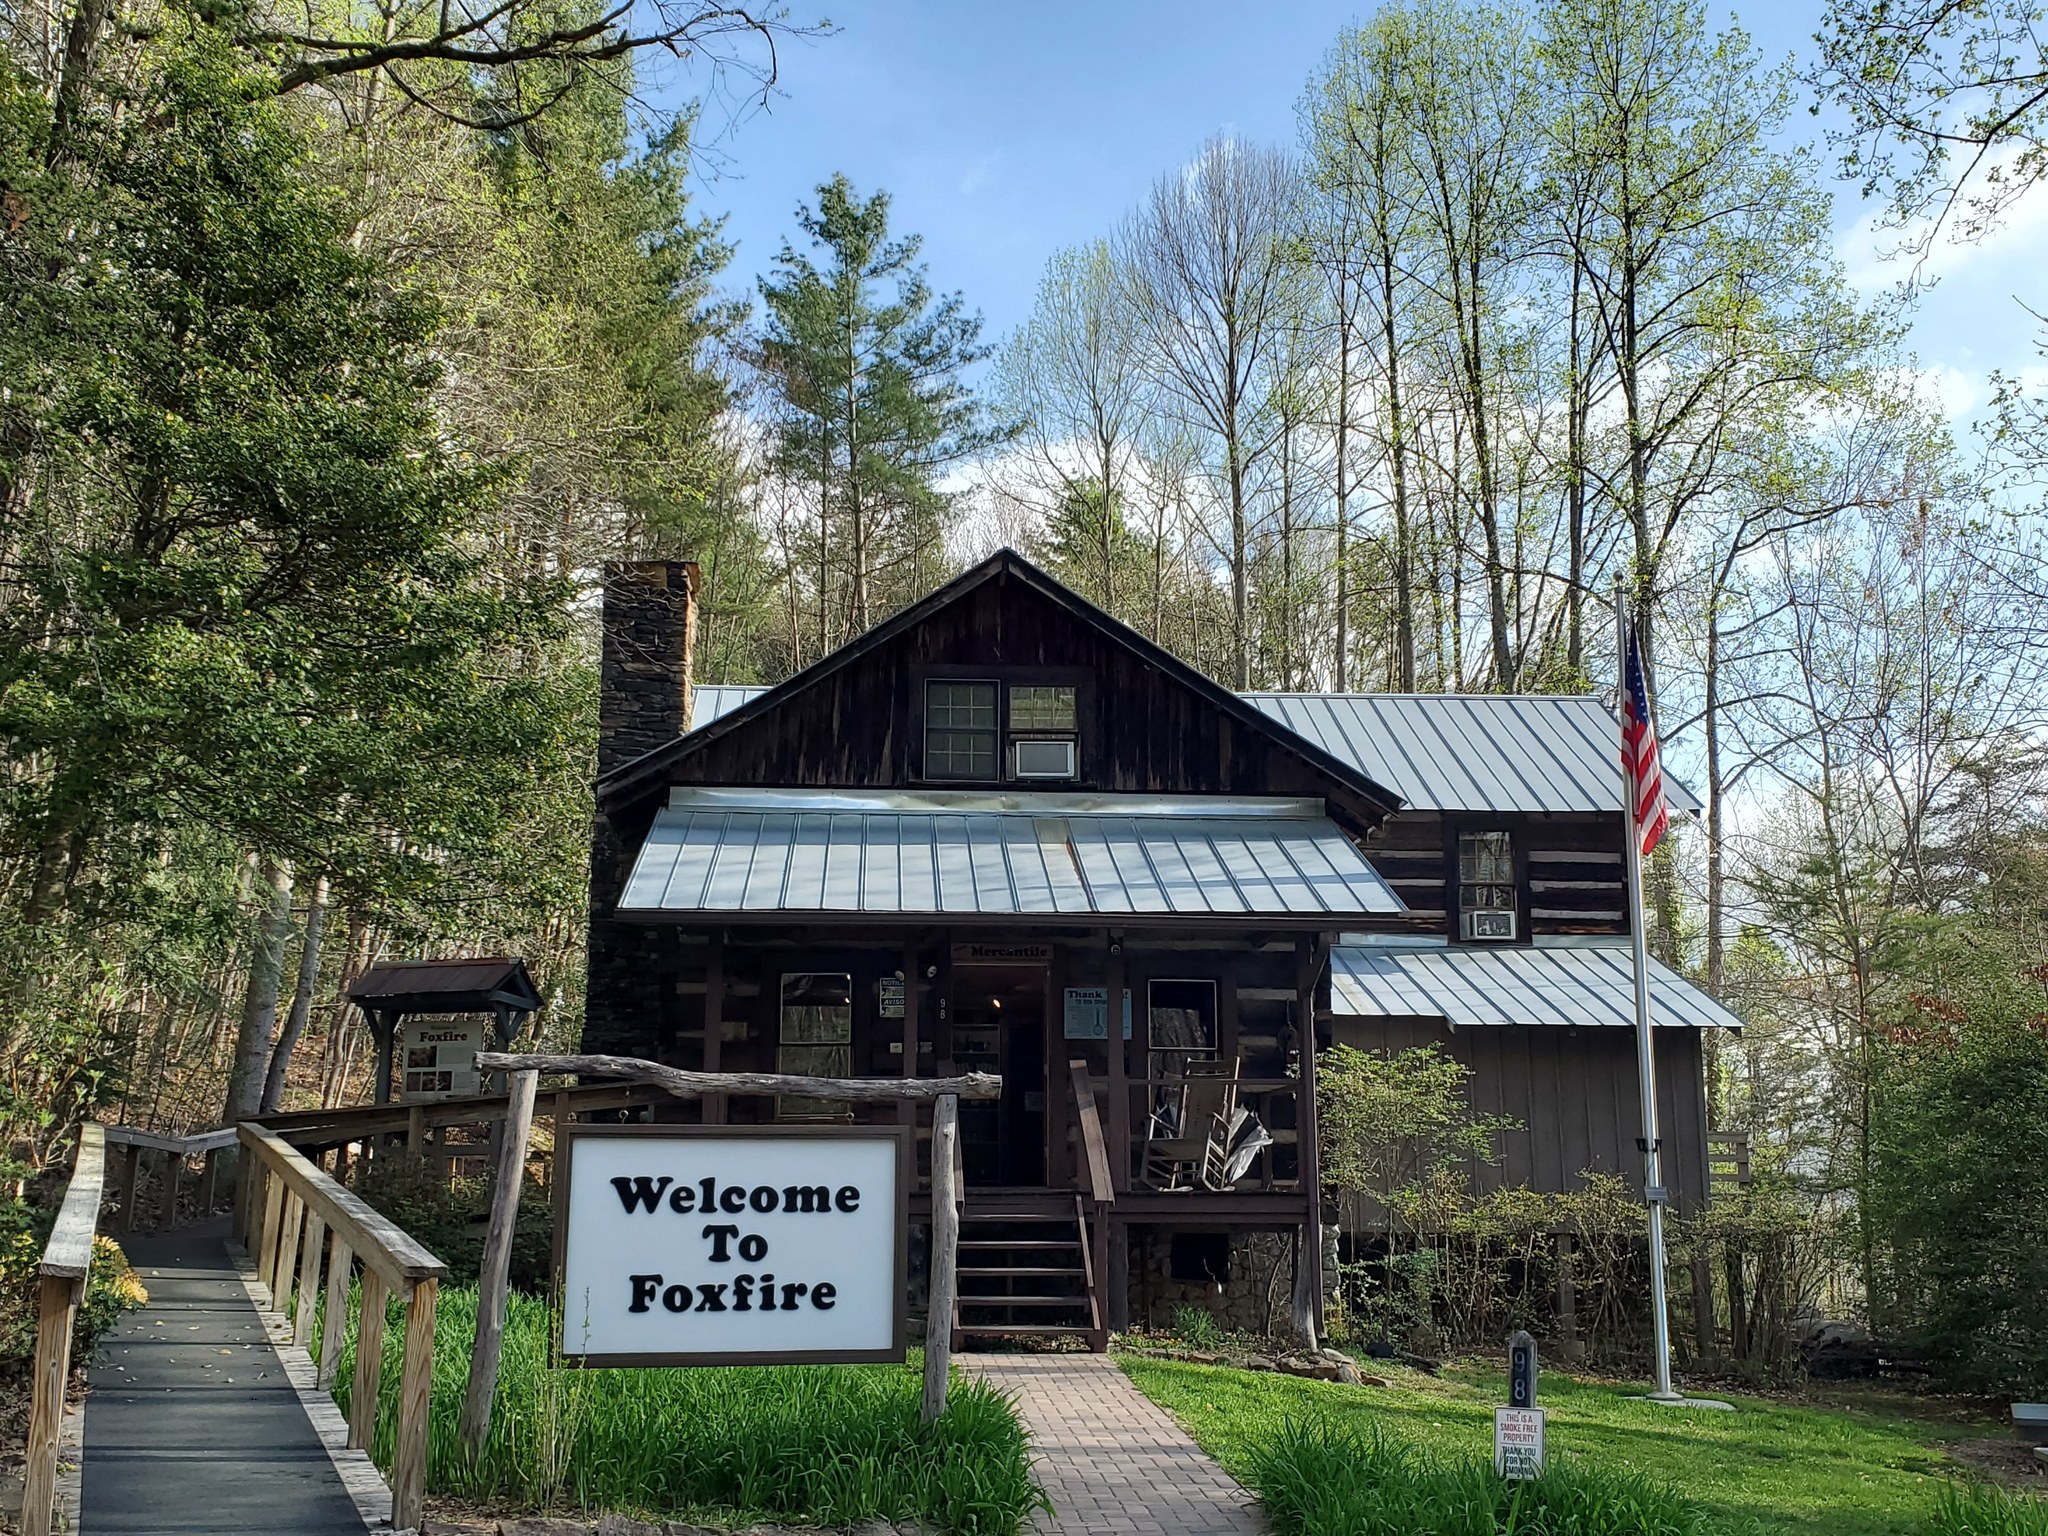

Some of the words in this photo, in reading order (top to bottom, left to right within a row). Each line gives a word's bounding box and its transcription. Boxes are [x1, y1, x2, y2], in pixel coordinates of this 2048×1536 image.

[971, 946, 1047, 957] Mercantile
[1068, 991, 1102, 999] Thank
[420, 1031, 468, 1042] Foxfire
[610, 1176, 860, 1214] Welcome
[702, 1224, 769, 1263] To
[628, 1274, 837, 1313] Foxfire
[1506, 1413, 1519, 1423] THIS
[1521, 1414, 1527, 1423] IS
[1528, 1415, 1533, 1423] A
[1500, 1423, 1521, 1432] SMOKE
[1523, 1424, 1538, 1433] FREE
[1503, 1433, 1535, 1443] PROPERTY
[1502, 1446, 1523, 1455] THANK
[1524, 1447, 1536, 1456] YOU
[1506, 1456, 1518, 1465] FOR
